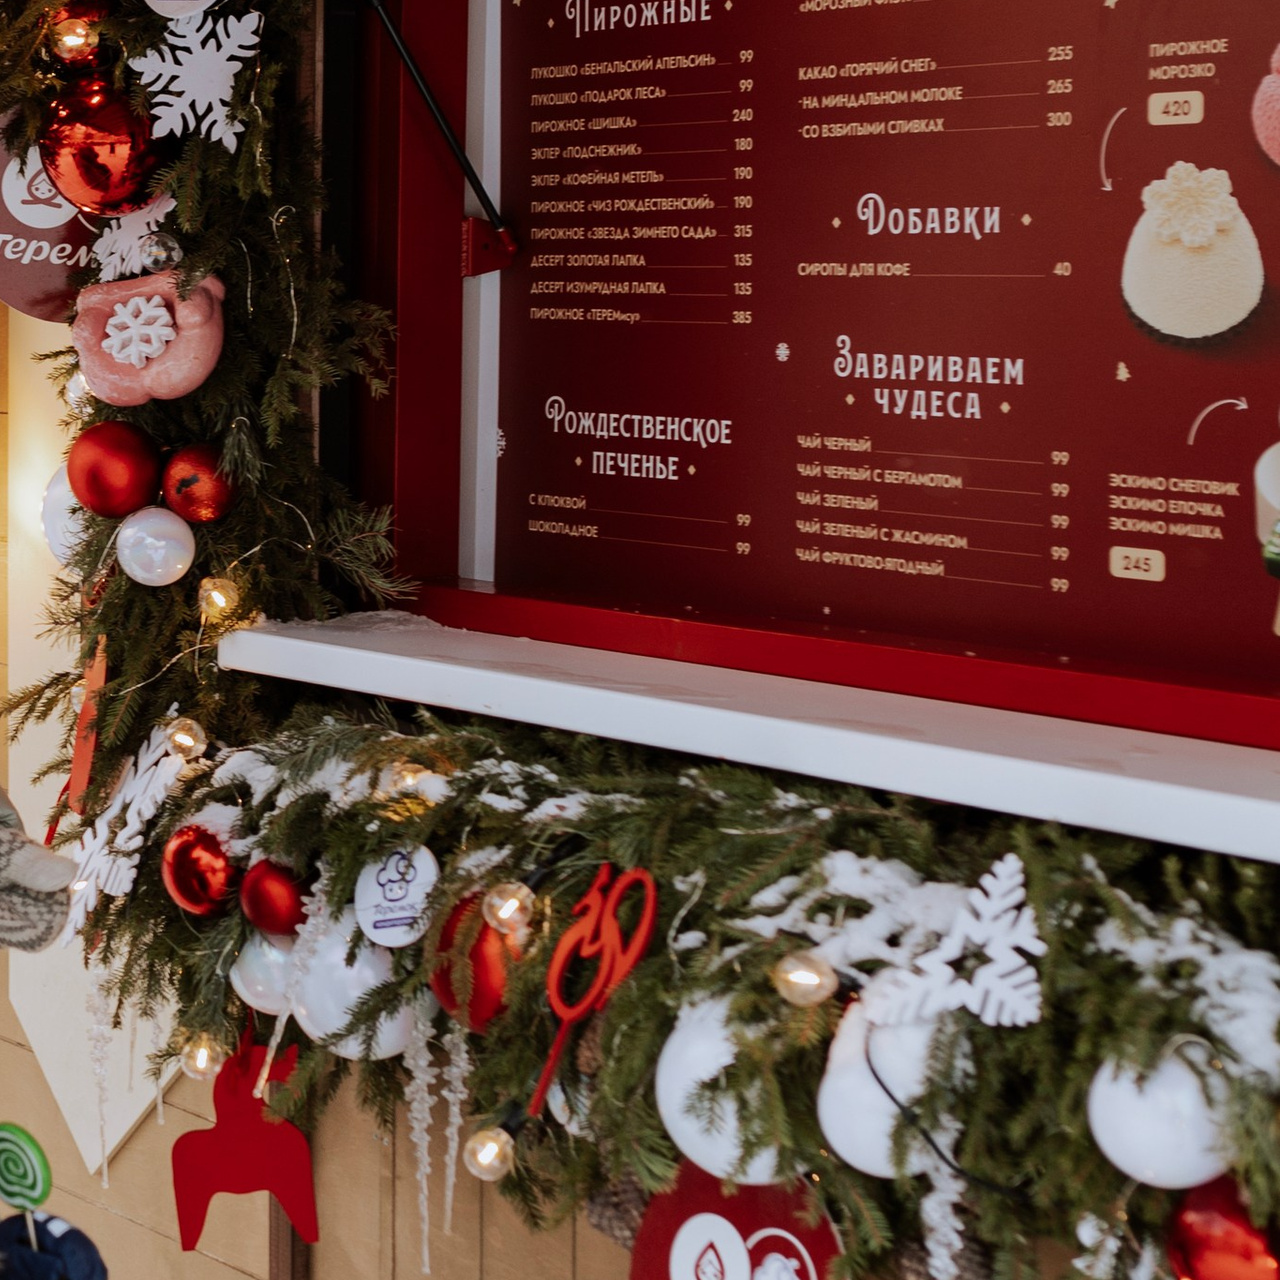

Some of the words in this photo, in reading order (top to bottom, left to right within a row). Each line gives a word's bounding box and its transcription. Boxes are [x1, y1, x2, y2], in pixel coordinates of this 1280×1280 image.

[1048, 46, 1073, 61] 255
[1149, 39, 1228, 57] ПИРОЖНОЕ
[740, 50, 753, 62] 99
[1148, 63, 1215, 80] МОРОЗКО
[740, 79, 753, 92] 99
[1162, 100, 1191, 116] 420
[733, 109, 753, 121] 240
[735, 138, 752, 150] 180
[734, 167, 752, 179] 190
[734, 196, 752, 208] 190
[734, 225, 752, 237] 315
[734, 254, 752, 266] 135
[1053, 262, 1071, 276] 40
[734, 283, 752, 295] 135
[733, 311, 752, 323] 385
[874, 388, 981, 420] ЧУДЕСА
[1051, 451, 1069, 465] 99
[592, 451, 679, 480] ПЕЧЕНЬЕ
[1051, 483, 1069, 497] 99
[737, 514, 751, 526] 99
[1051, 515, 1069, 528] 99
[737, 542, 750, 554] 99
[1122, 555, 1152, 572] 245
[1051, 578, 1069, 592] 99
